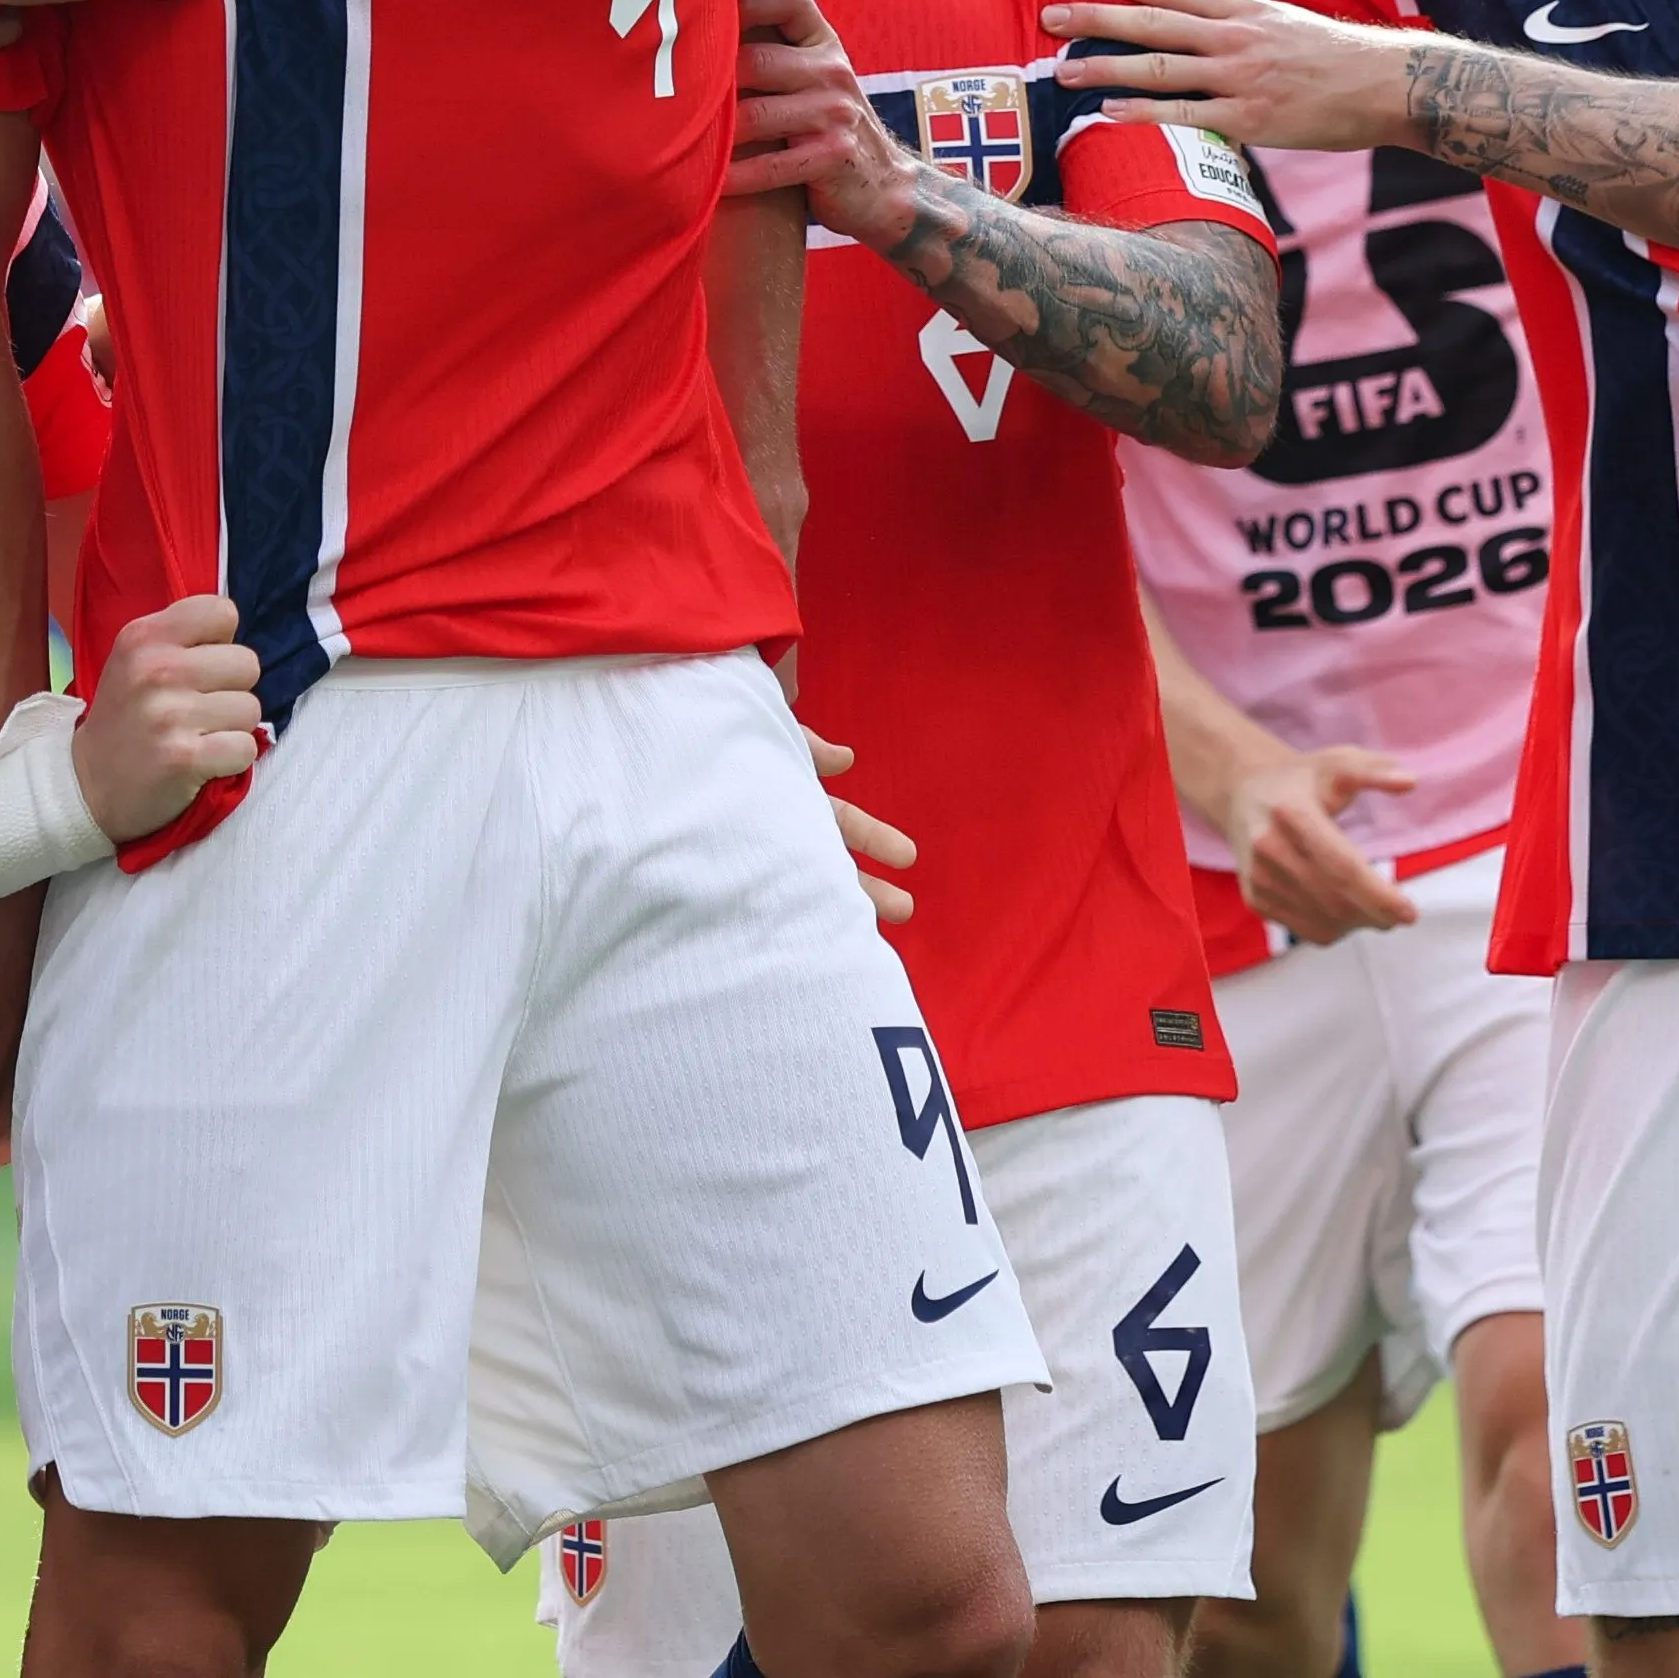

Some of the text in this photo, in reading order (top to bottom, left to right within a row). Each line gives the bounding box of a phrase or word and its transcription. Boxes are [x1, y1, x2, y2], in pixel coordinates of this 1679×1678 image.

[952, 79, 987, 92] NORGE
[1290, 367, 1446, 440] FIFA
[1237, 470, 1542, 554] WORLD CUP
[1240, 525, 1550, 632] 2026
[871, 1026, 978, 1225] 9
[160, 1309, 190, 1320] NORGE
[1113, 1243, 1213, 1441] 6
